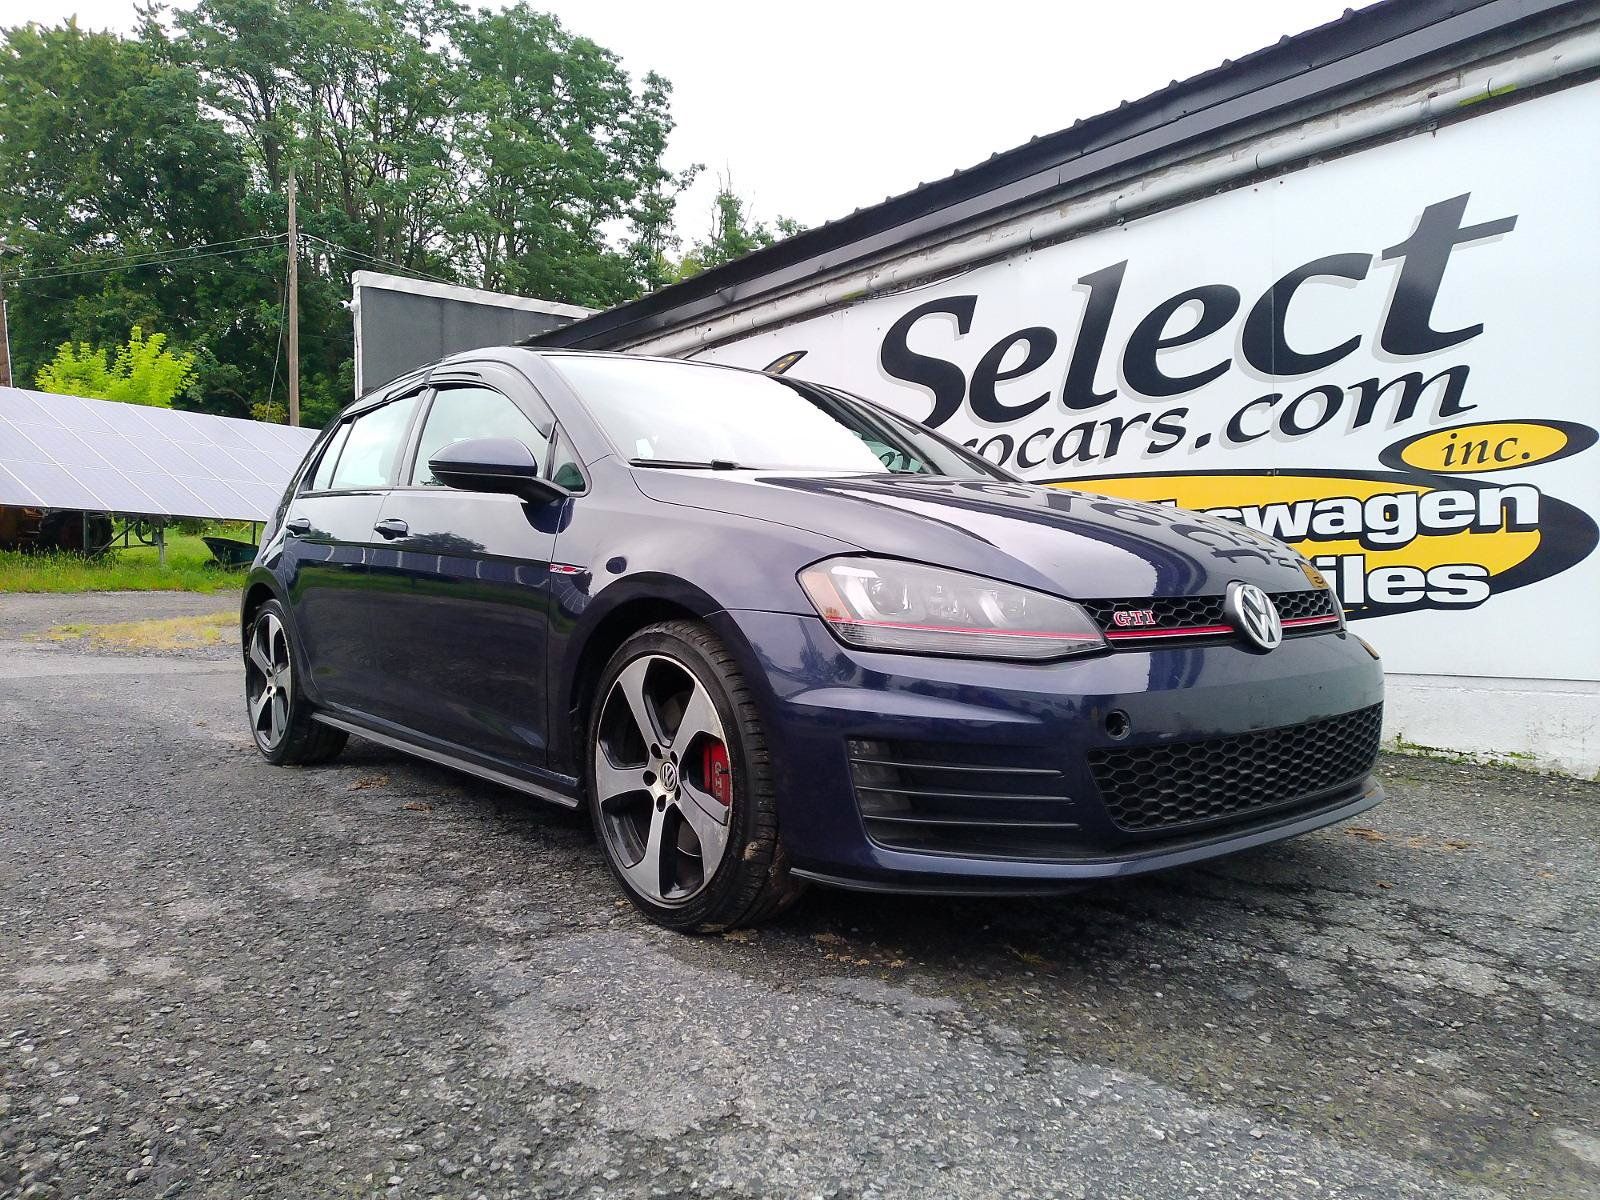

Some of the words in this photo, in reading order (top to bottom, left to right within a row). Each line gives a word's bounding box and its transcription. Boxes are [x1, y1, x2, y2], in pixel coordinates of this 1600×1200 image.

[880, 191, 1518, 429] Select
[1442, 432, 1531, 467] inc.
[1112, 610, 1156, 627] GTI
